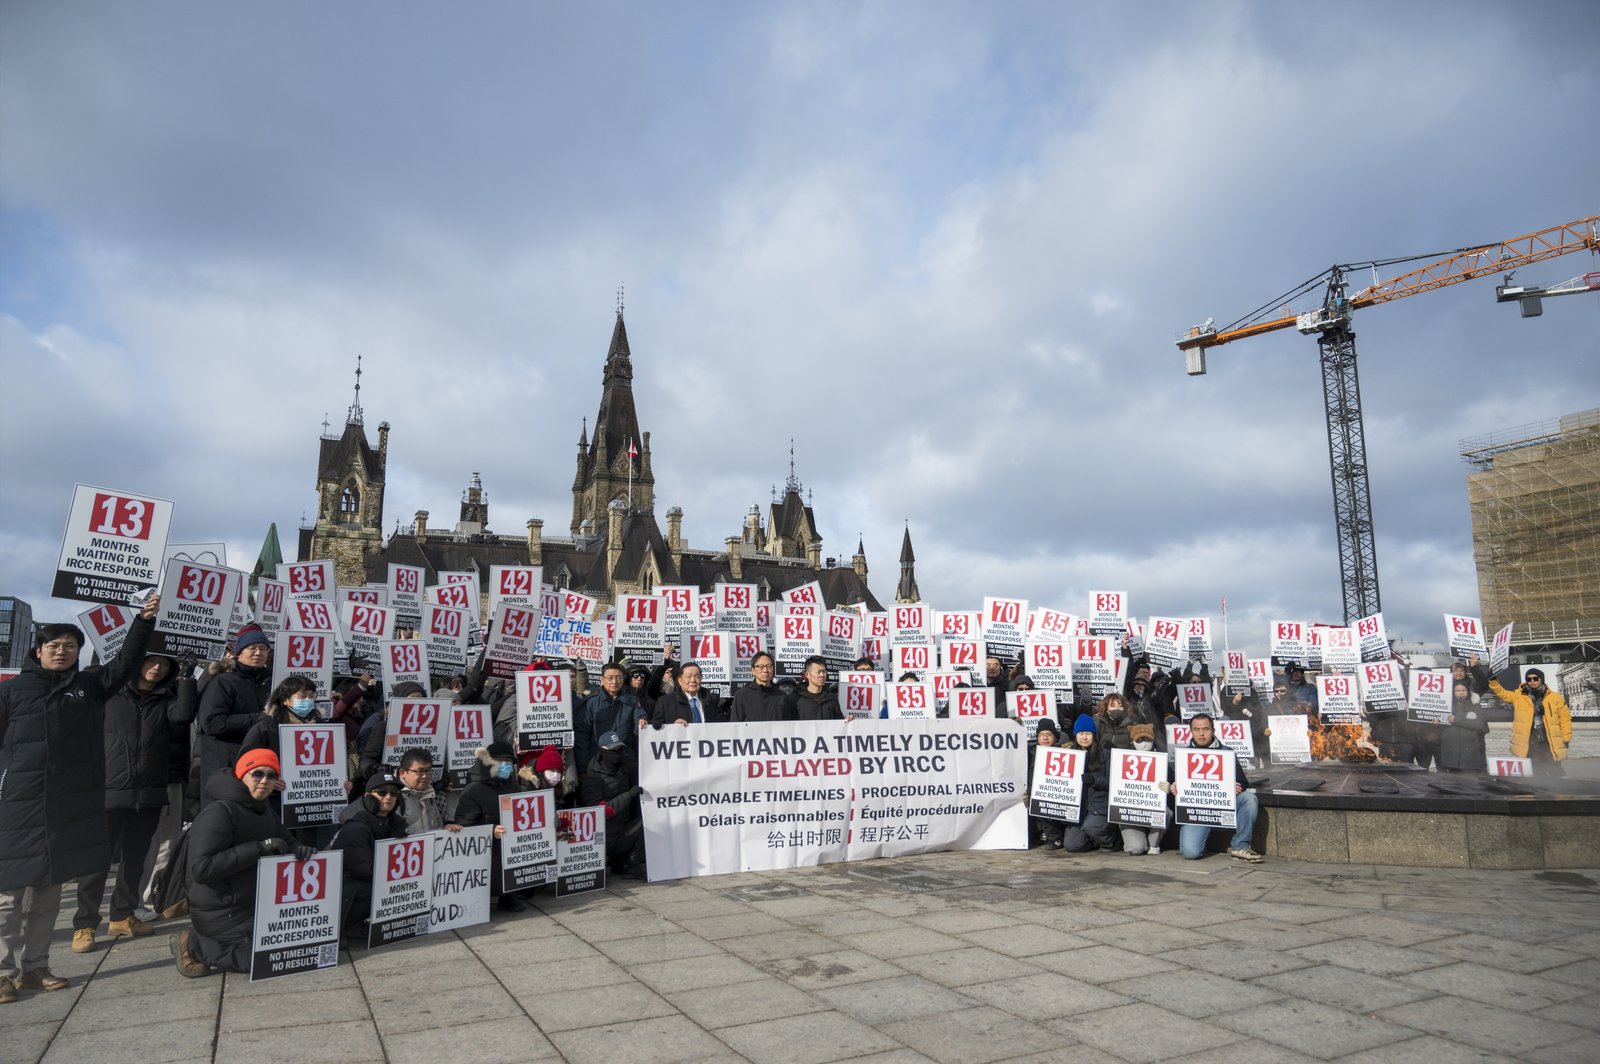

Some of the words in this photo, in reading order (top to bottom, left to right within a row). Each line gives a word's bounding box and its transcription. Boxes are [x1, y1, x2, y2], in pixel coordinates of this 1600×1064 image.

[97, 496, 145, 538] 13
[91, 538, 140, 553] MONTHS
[76, 547, 124, 563] WAITING
[128, 556, 150, 567] FOR
[66, 558, 92, 570] IRCC
[93, 562, 154, 579] RESPONSE
[74, 576, 89, 586] NO
[90, 578, 140, 592] TIMELINES
[182, 568, 221, 604] 30
[293, 566, 322, 592] 35
[399, 569, 417, 592] 39
[504, 571, 528, 594] 42
[76, 587, 91, 596] NO
[92, 589, 132, 602] RESULTS
[264, 584, 282, 612] 20
[441, 586, 466, 608] 32
[566, 594, 586, 613] 31
[666, 590, 687, 611] 15
[727, 587, 747, 608] 53
[794, 586, 812, 602] 33
[1099, 594, 1118, 611] 38
[101, 605, 115, 629] 4
[167, 611, 202, 623] WAITING
[204, 616, 221, 626] FOR
[178, 603, 214, 616] MONTHS
[301, 603, 330, 629] 36
[630, 599, 653, 622] 11
[900, 608, 919, 627] 90
[995, 602, 1017, 623] 70
[160, 620, 181, 630] IRCC
[181, 623, 224, 637] RESPONSE
[354, 606, 382, 634] 20
[434, 610, 458, 636] 40
[504, 609, 529, 637] 54
[568, 621, 592, 634] THE
[787, 618, 810, 639] 34
[832, 617, 851, 638] 68
[946, 615, 966, 634] 33
[1044, 612, 1066, 633] 35
[1360, 618, 1377, 637] 33
[1456, 618, 1474, 632] 37
[352, 634, 378, 644] MONTHS
[1157, 621, 1177, 640] 32
[1280, 623, 1298, 640] 31
[1330, 631, 1349, 646] 34
[433, 636, 456, 645] MONTHS
[502, 636, 524, 646] MONTHS
[694, 636, 717, 657] 71
[740, 636, 758, 658] 53
[1081, 640, 1102, 660] 11
[290, 636, 320, 667] 34
[394, 645, 418, 671] 38
[904, 648, 925, 668] 40
[952, 644, 974, 663] 72
[1037, 645, 1059, 666] 65
[1231, 652, 1242, 668] 37
[1367, 664, 1392, 682] 39
[533, 676, 558, 702] 62
[1327, 678, 1349, 696] 39
[1419, 674, 1443, 692] 25
[850, 687, 868, 709] 81
[900, 687, 923, 707] 35
[962, 692, 983, 715] 43
[1185, 687, 1203, 702] 37
[1020, 694, 1045, 716] 34
[405, 705, 435, 734] 42
[459, 711, 481, 738] 41
[523, 721, 538, 730] IRCC
[538, 720, 568, 728] RESPONSE
[526, 712, 551, 721] WAITING
[1223, 724, 1243, 739] 23
[300, 732, 329, 764] 37
[651, 740, 691, 760] WE
[699, 737, 807, 758] DEMAND
[813, 736, 829, 753] A
[833, 734, 913, 753] TIMELY
[919, 733, 1018, 751] DECISION
[300, 769, 330, 778] MONTHS
[748, 757, 852, 778] DELAYED
[859, 756, 887, 774] BY
[894, 755, 946, 773] IRCC
[1049, 752, 1071, 778] 51
[1126, 756, 1152, 781] 37
[1192, 754, 1219, 780] 22
[1500, 760, 1523, 776] 14
[292, 780, 323, 790] WAITING
[325, 779, 338, 787] FOR
[862, 785, 952, 798] PROCEDURAL
[956, 782, 1015, 795] FAIRNESS
[1124, 783, 1152, 791] MONTHS
[288, 791, 304, 800] IRCC
[304, 789, 343, 798] RESPONSE
[656, 791, 761, 809] REASONABLE
[766, 788, 845, 802] TIMELINES
[1196, 798, 1231, 806] RESPONSE
[516, 796, 542, 831] 31
[699, 814, 745, 828] Délais
[750, 810, 844, 824] raisonnables
[860, 805, 903, 821] Équité
[906, 803, 984, 819] procédurale
[573, 813, 594, 841] 40
[860, 824, 929, 843] 程序公平
[517, 833, 542, 842] MONTHS
[767, 829, 841, 848] 给出时限
[390, 842, 421, 879] 36
[282, 860, 320, 903] 18
[389, 881, 418, 894] MONTHS
[462, 868, 488, 891] ARE
[381, 892, 411, 906] WAITING
[412, 890, 424, 902] FOR
[279, 905, 319, 918] MONTHS
[376, 907, 392, 919] IRCC
[392, 900, 428, 915] RESPONSE
[430, 904, 446, 926] OU
[268, 918, 309, 932] WAITING
[311, 916, 328, 926] FOR
[260, 934, 284, 946] IRCC
[285, 927, 333, 942] RESPONSE
[272, 962, 283, 972] NO
[285, 956, 319, 969] RESULTS
